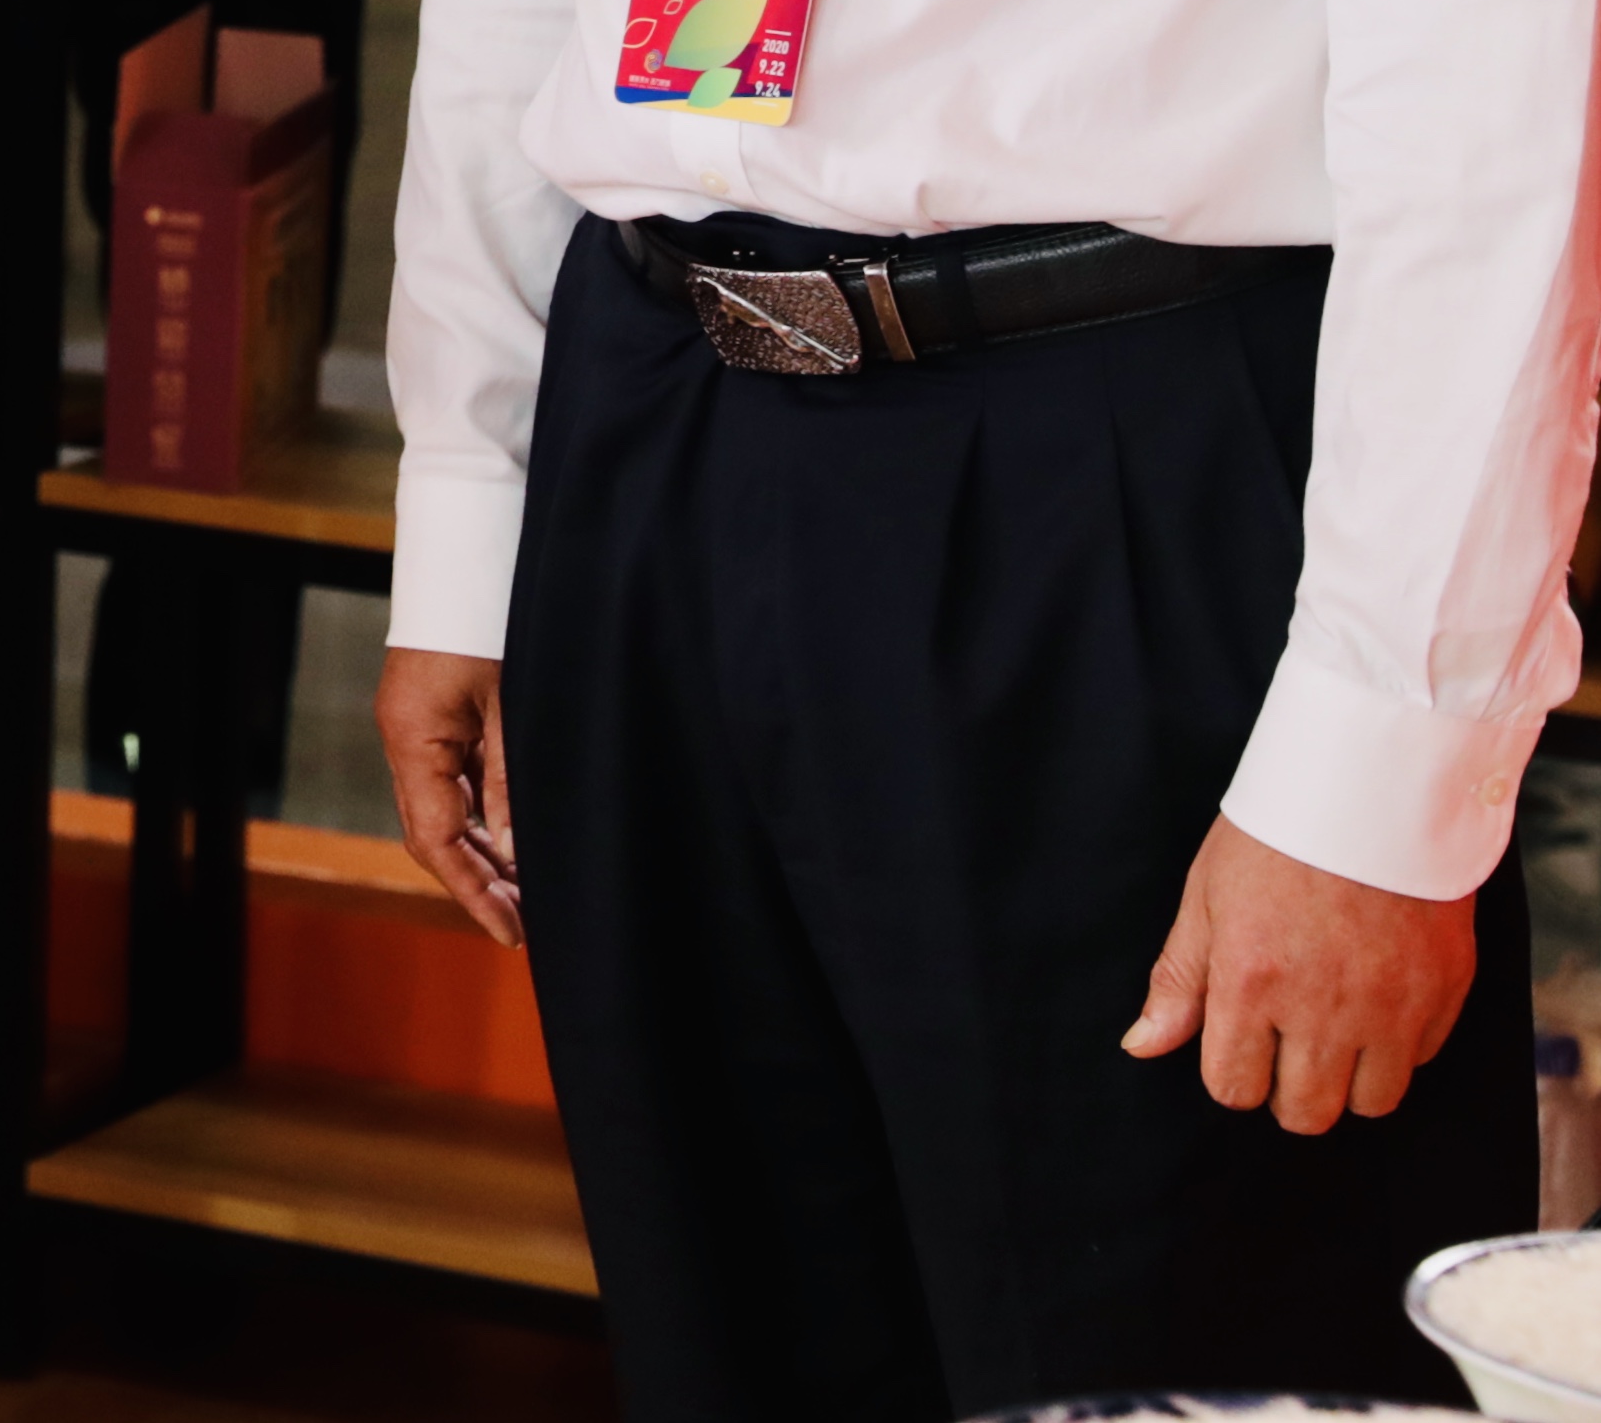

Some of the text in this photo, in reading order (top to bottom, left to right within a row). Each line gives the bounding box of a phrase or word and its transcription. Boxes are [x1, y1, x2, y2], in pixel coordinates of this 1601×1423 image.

[762, 39, 789, 55] 2020
[759, 59, 785, 77] 9.22
[755, 81, 781, 99] 9.24
